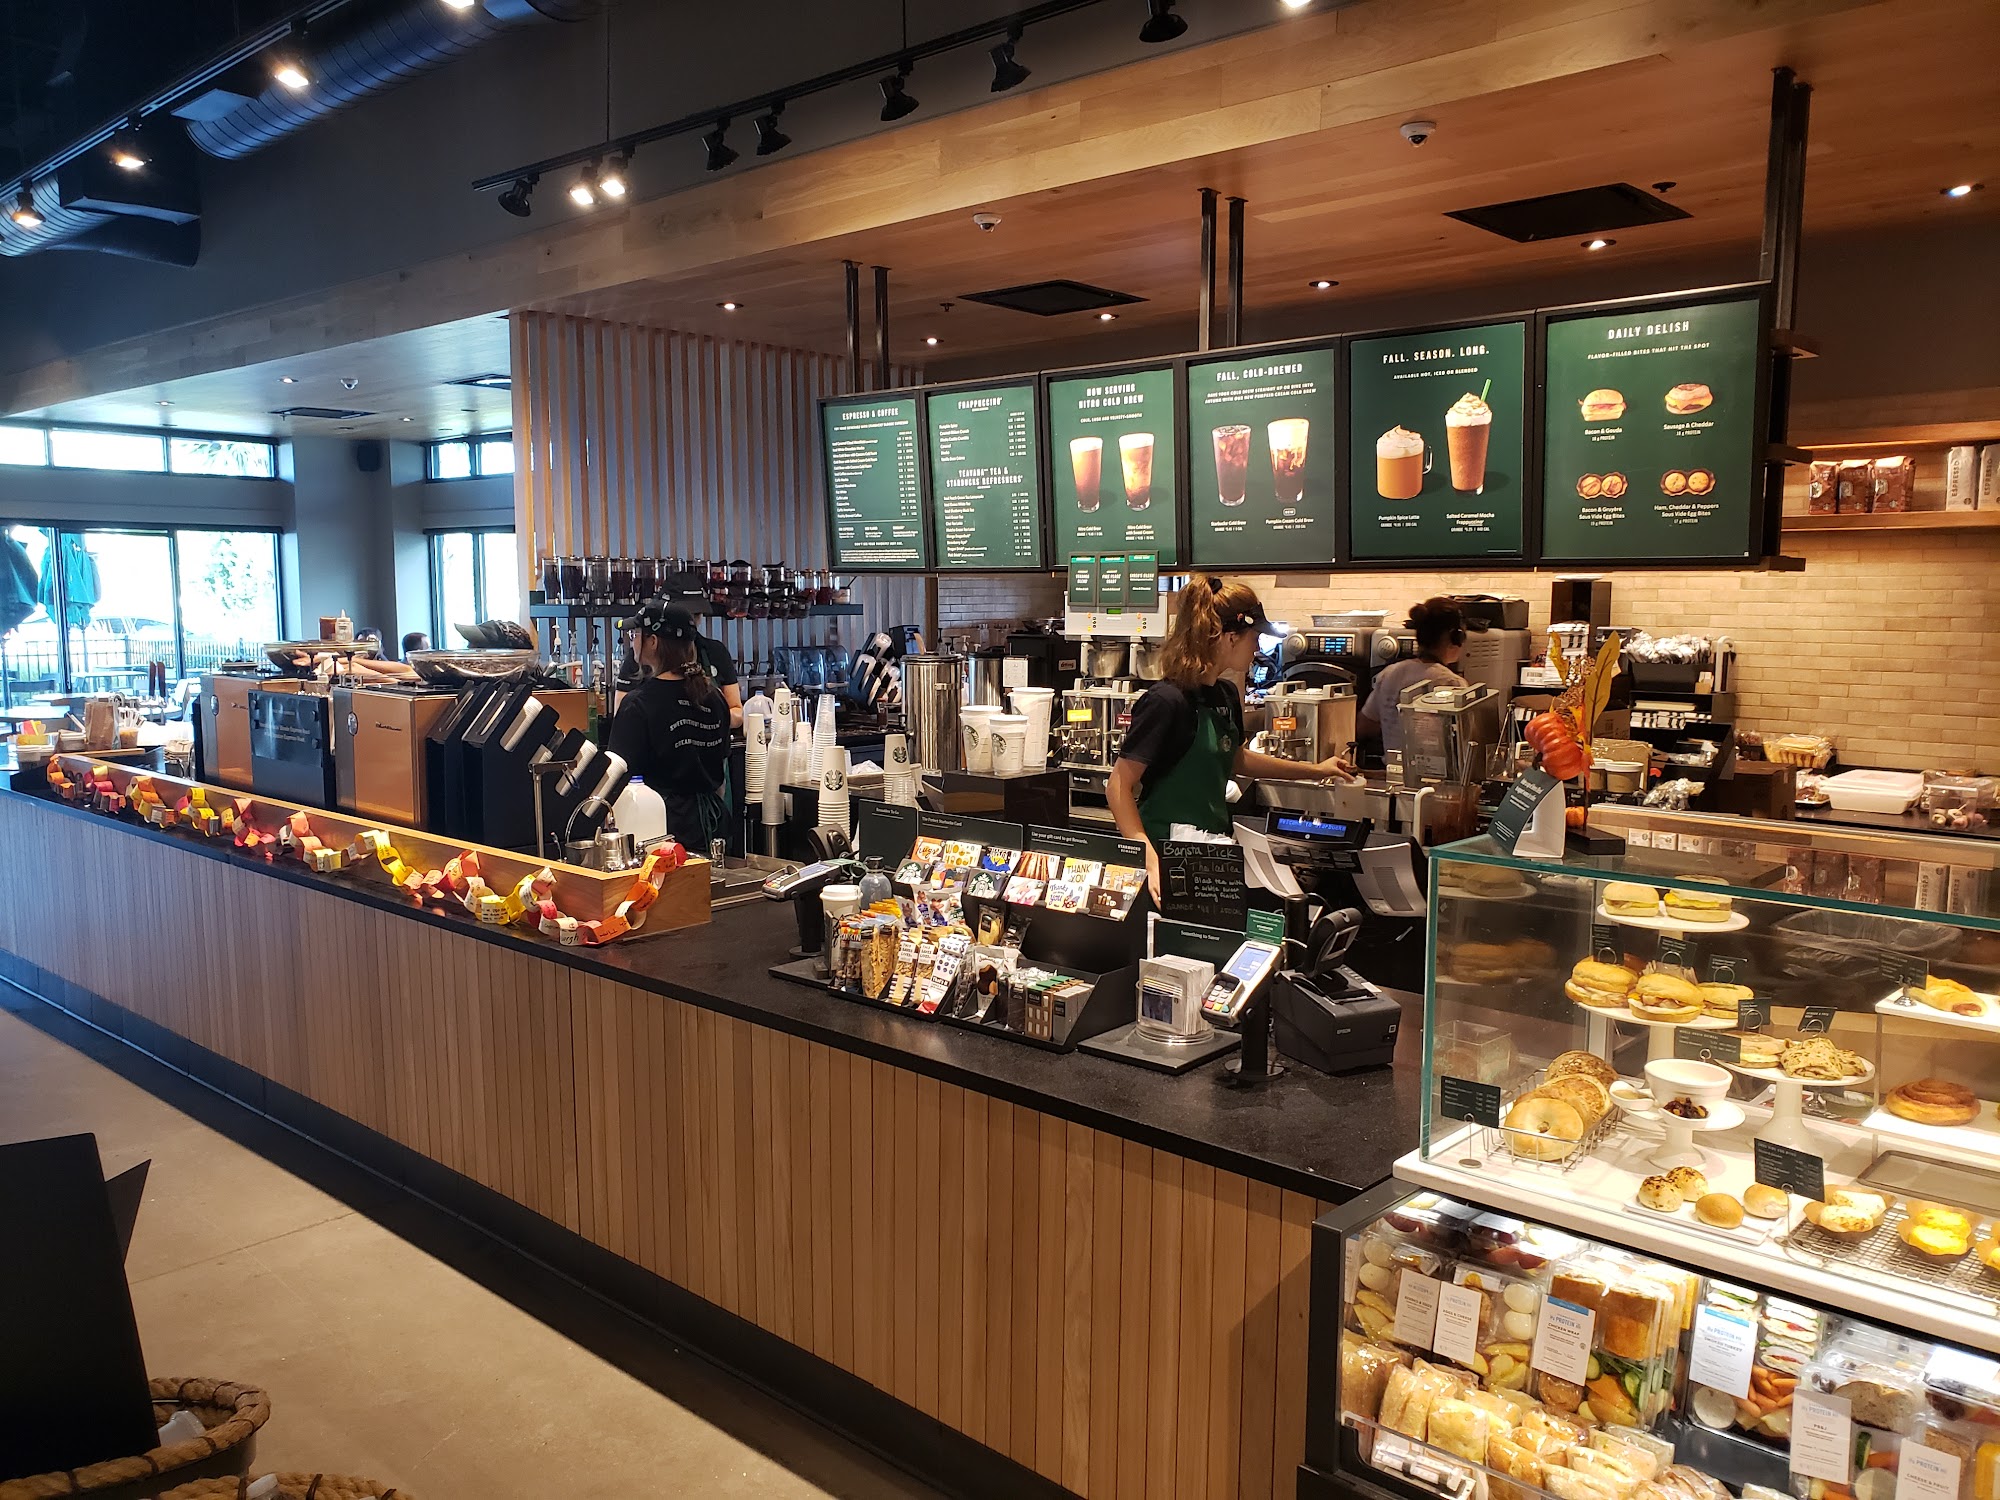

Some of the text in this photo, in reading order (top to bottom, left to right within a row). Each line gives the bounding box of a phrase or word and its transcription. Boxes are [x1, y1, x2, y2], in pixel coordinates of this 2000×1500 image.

[1608, 321, 1689, 340] DAILY DELISH
[1383, 345, 1489, 364] FALL. SEASON. LONG.
[1588, 350, 1631, 360] FLAVOR-FILLED
[1216, 364, 1303, 381] FALL, COLD-BREWED
[1086, 384, 1136, 397] NOW SERVING
[1079, 394, 1144, 409] NITRO COLD BREW
[842, 410, 870, 421] ESPRESSO
[877, 408, 899, 417] COFFEE
[990, 467, 1002, 476] TEA
[1984, 458, 1993, 496] ESPRESSO
[946, 478, 980, 488] STARBUCKS
[1952, 461, 1960, 497] ESPRESSO
[1117, 844, 1141, 852] STARBUCKS
[1163, 841, 1238, 858] Barista Pick
[1067, 863, 1092, 873] THANK
[1224, 862, 1242, 873] Tea
[1069, 874, 1087, 883] YOU
[1050, 884, 1069, 892] Thanks
[1195, 892, 1219, 903] creamy
[1181, 930, 1203, 939] Something
[1548, 1323, 1566, 1332] CHICKEN
[1556, 1317, 1575, 1328] PROTEIN
[1714, 1328, 1735, 1338] PROTEIN
[1725, 1342, 1743, 1352] TURKEY
[1809, 1406, 1832, 1417] PROTEIN
[1916, 1460, 1939, 1472] PROTEIN
[1907, 1474, 1927, 1483] CHEESE
